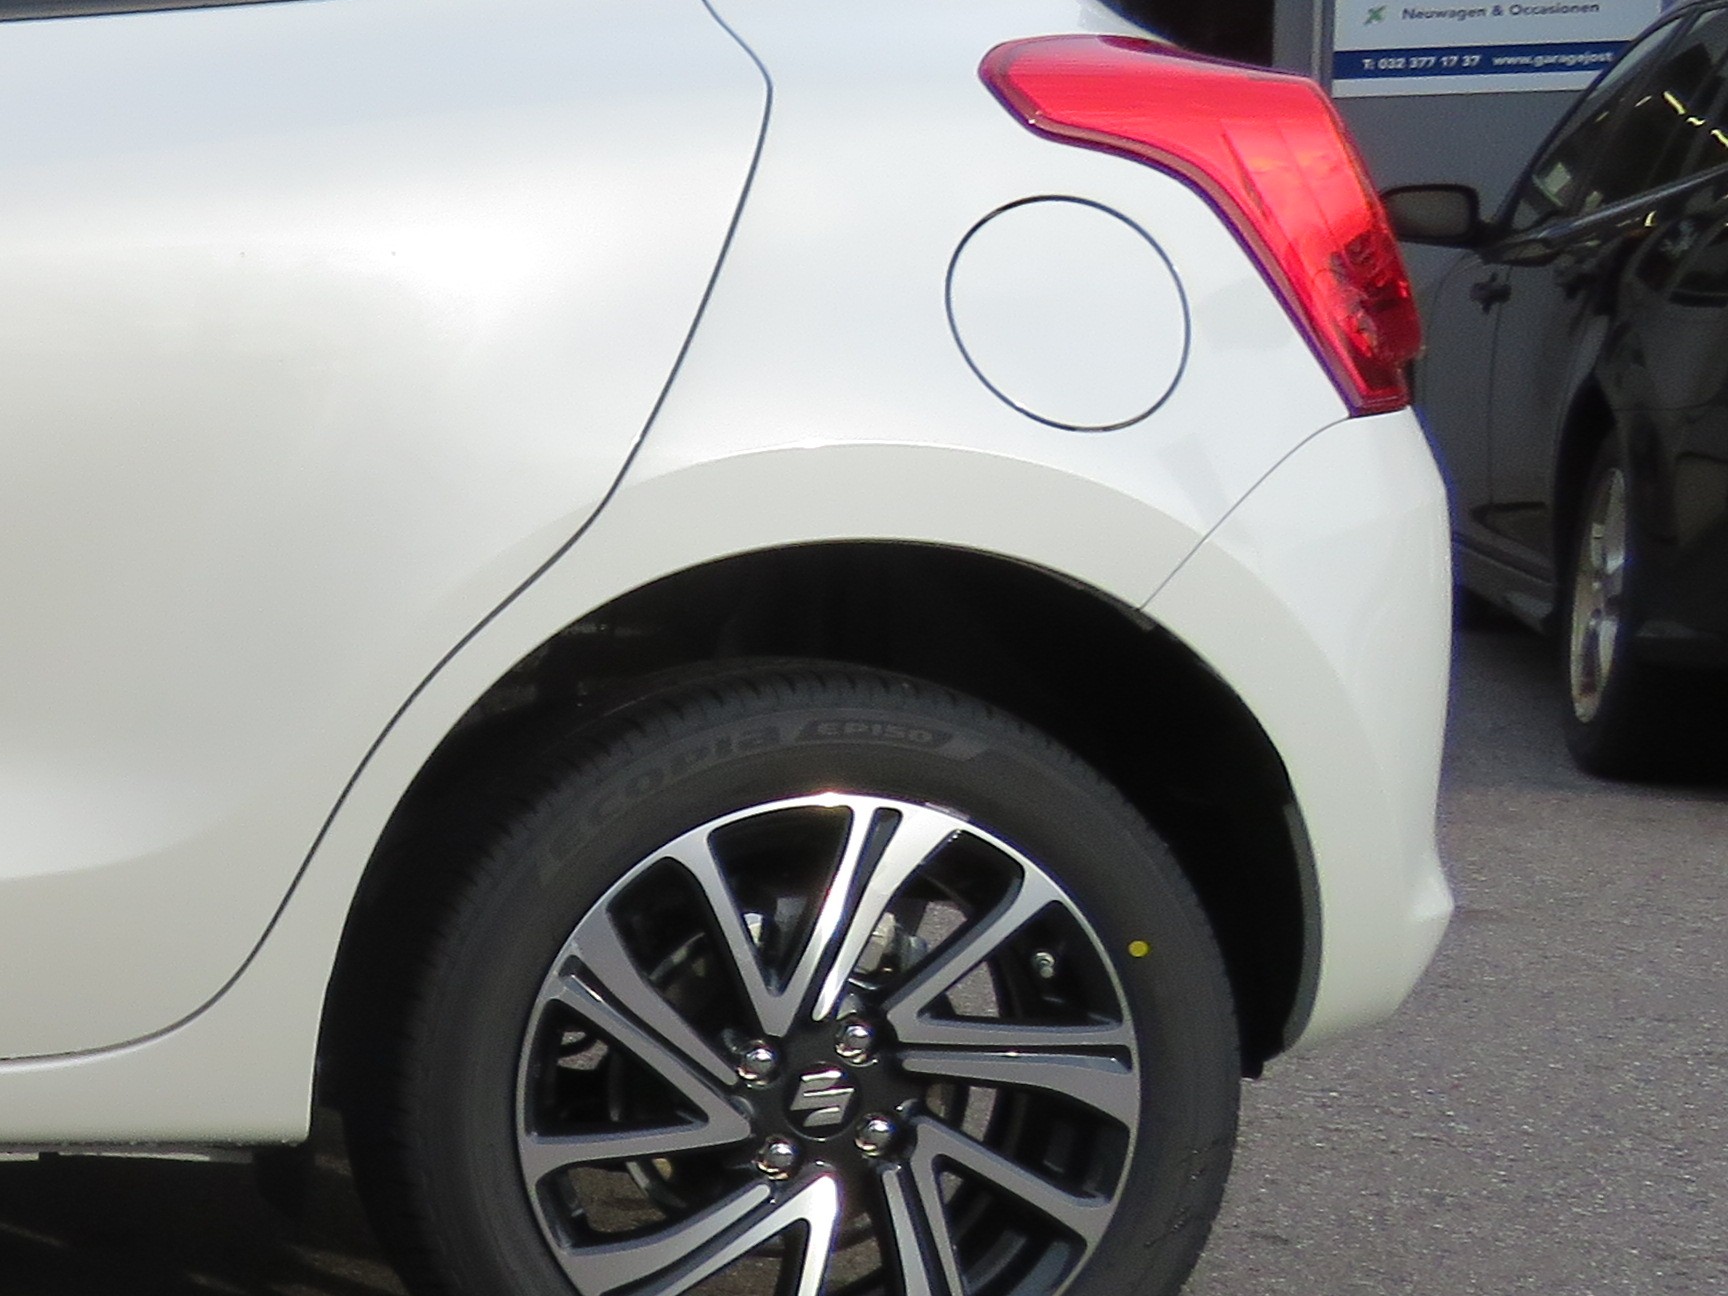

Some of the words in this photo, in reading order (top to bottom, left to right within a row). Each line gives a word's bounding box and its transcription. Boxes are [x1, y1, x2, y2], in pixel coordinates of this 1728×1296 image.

[1402, 6, 1487, 22] Neuwagen
[1491, 4, 1504, 17] &
[1509, 1, 1600, 16] Occasionen
